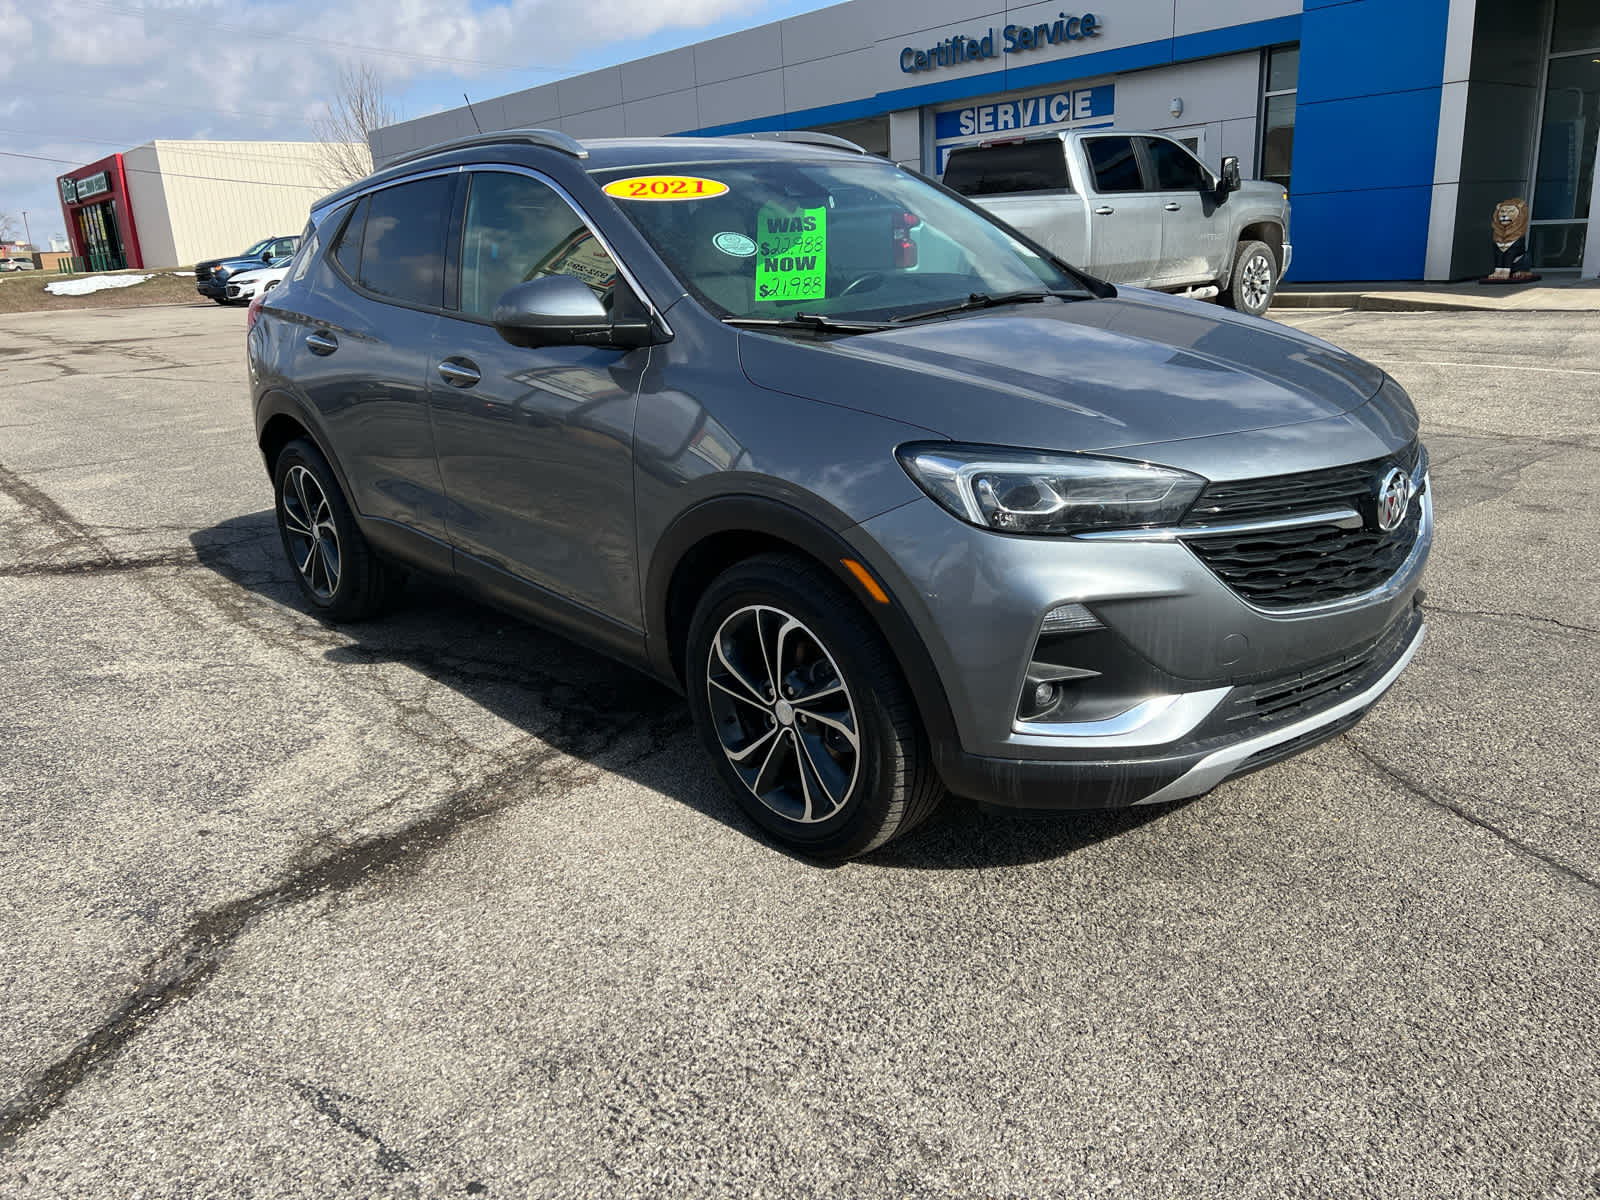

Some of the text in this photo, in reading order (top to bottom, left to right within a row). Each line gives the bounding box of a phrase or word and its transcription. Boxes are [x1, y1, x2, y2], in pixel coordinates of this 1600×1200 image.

[900, 12, 1096, 73] Certified Service
[959, 90, 1092, 135] SERVICE
[629, 180, 704, 196] 2021
[767, 215, 817, 234] WAS
[764, 255, 817, 273] NOW
